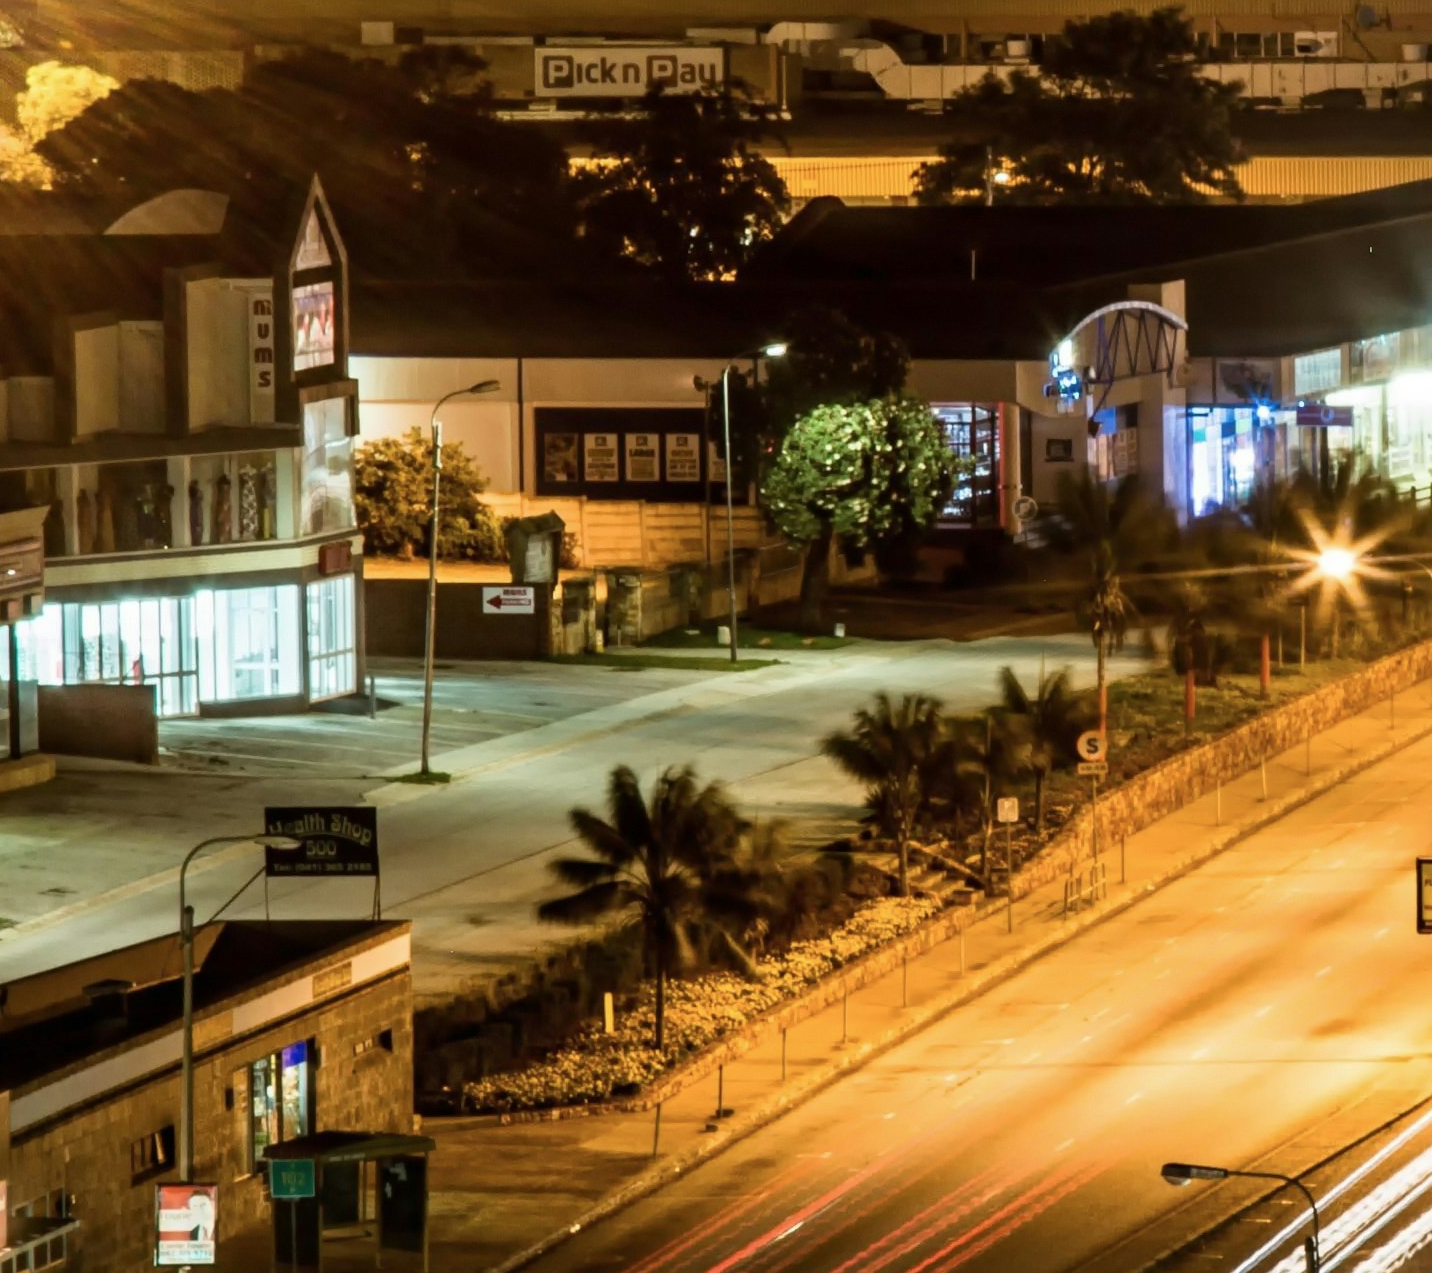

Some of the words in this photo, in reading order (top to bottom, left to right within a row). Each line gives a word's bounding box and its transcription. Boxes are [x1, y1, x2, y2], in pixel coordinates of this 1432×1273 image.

[543, 55, 617, 88] Pick
[646, 55, 717, 88] Pay
[331, 814, 372, 846] Shop
